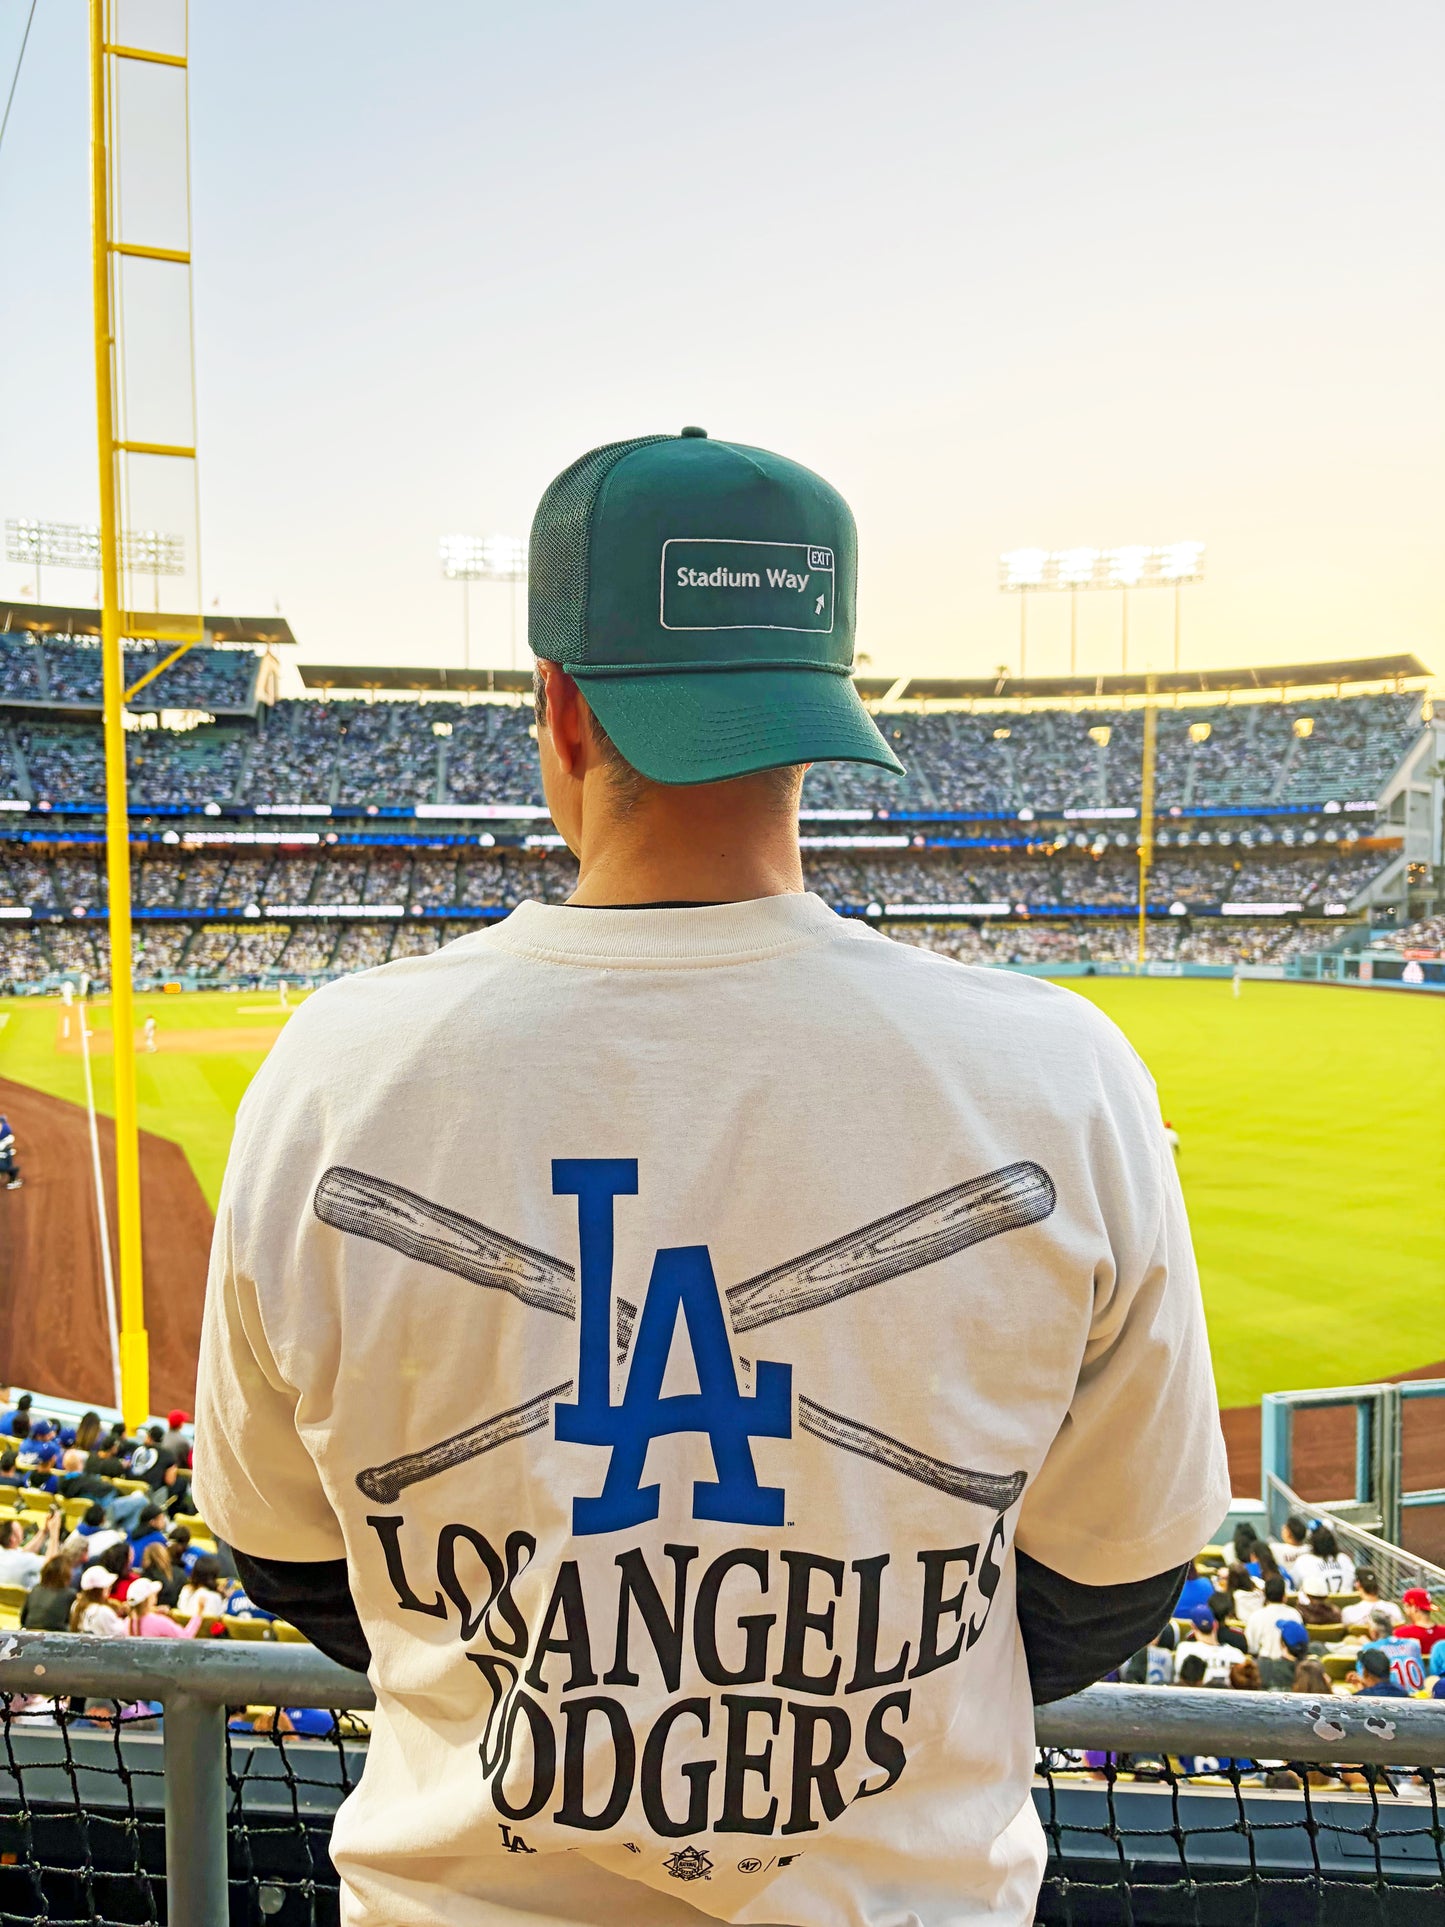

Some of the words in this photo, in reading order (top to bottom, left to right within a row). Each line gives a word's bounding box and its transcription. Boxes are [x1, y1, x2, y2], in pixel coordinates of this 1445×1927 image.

[811, 551, 831, 566] EXIT
[677, 567, 760, 588] Stadium
[766, 568, 809, 592] Way
[551, 1158, 793, 1537] LA
[1325, 1575, 1343, 1593] 17
[366, 1515, 537, 1659] LOS
[524, 1514, 1005, 1697] ANGELES
[1389, 1660, 1423, 1690] 10
[465, 1653, 912, 1838] DODGERS
